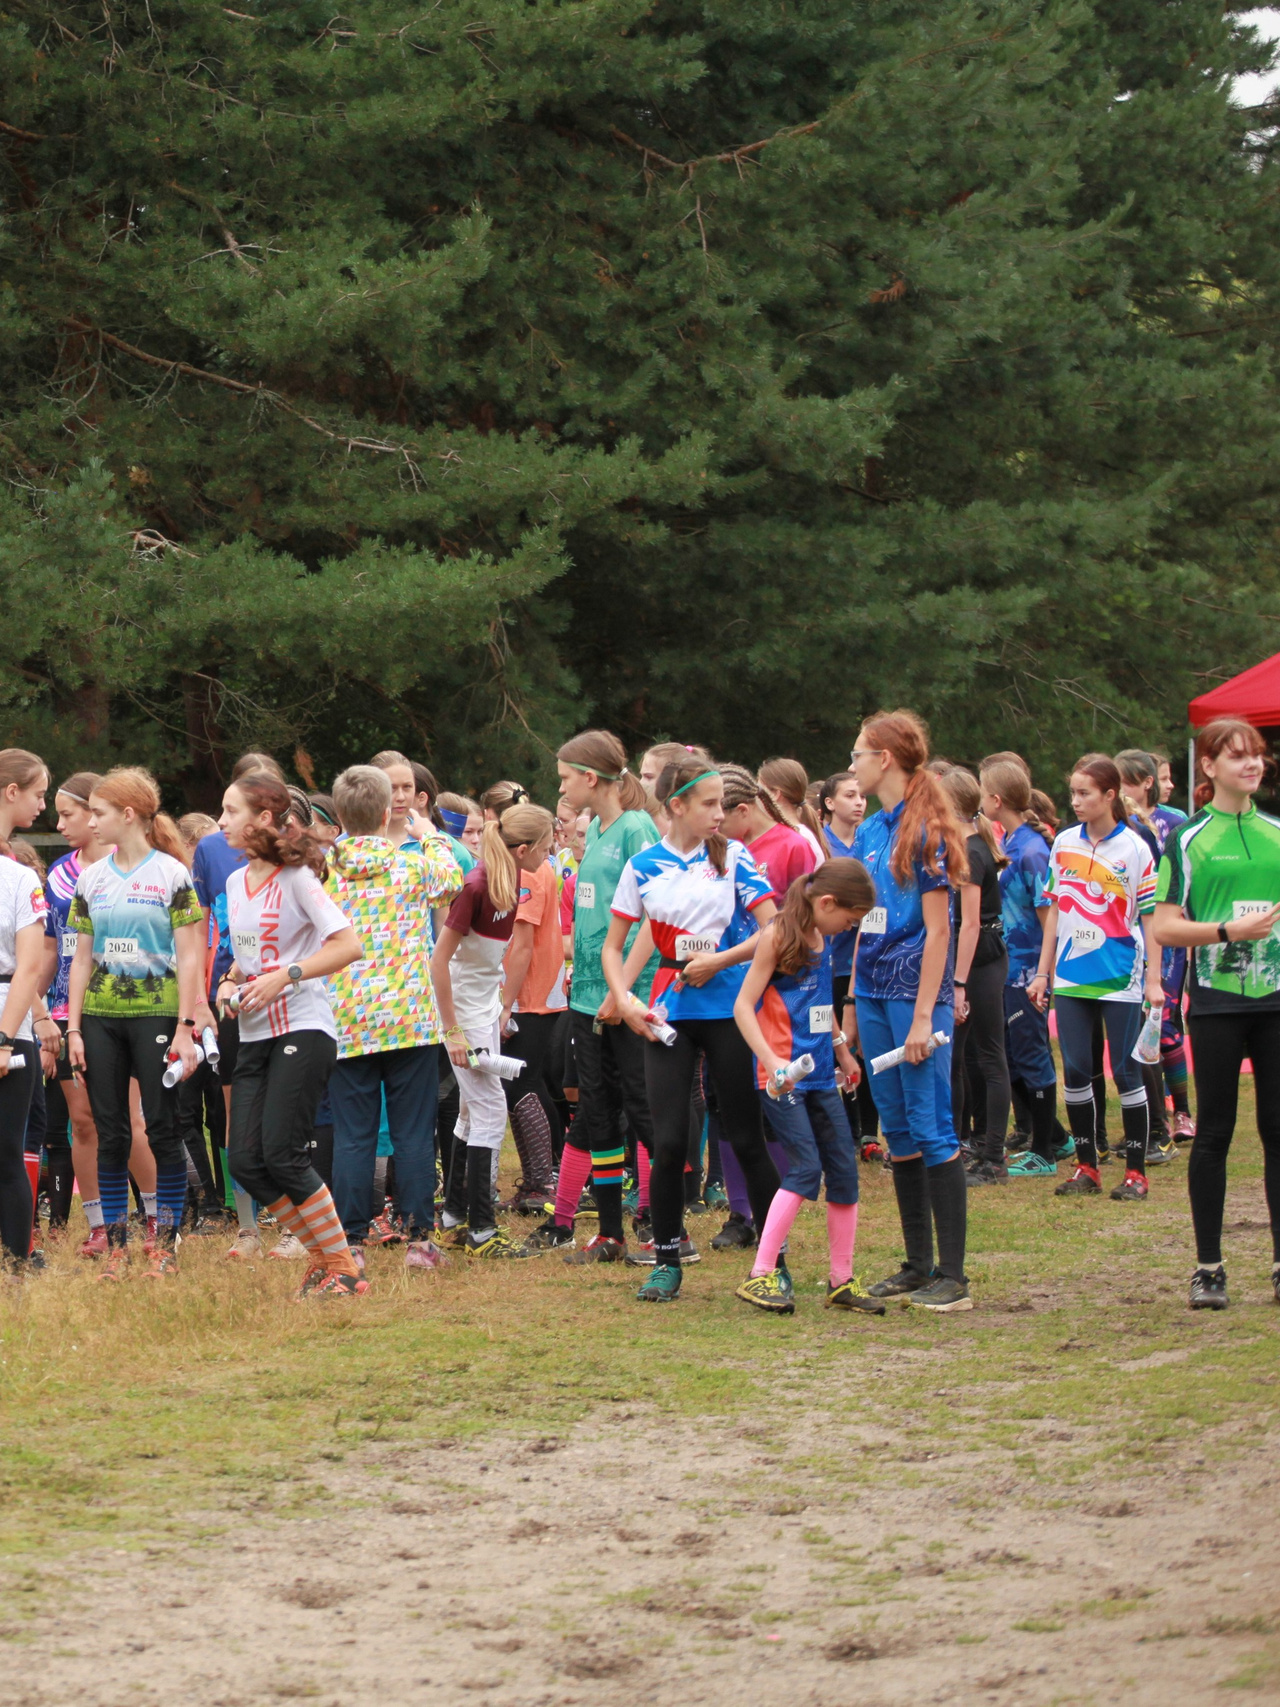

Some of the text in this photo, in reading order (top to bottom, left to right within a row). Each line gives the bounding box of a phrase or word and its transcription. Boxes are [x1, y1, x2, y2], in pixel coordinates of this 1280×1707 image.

[1075, 929, 1096, 940] 2051
[237, 935, 256, 946] 2002
[681, 940, 710, 951] 2006
[108, 942, 133, 953] 2020
